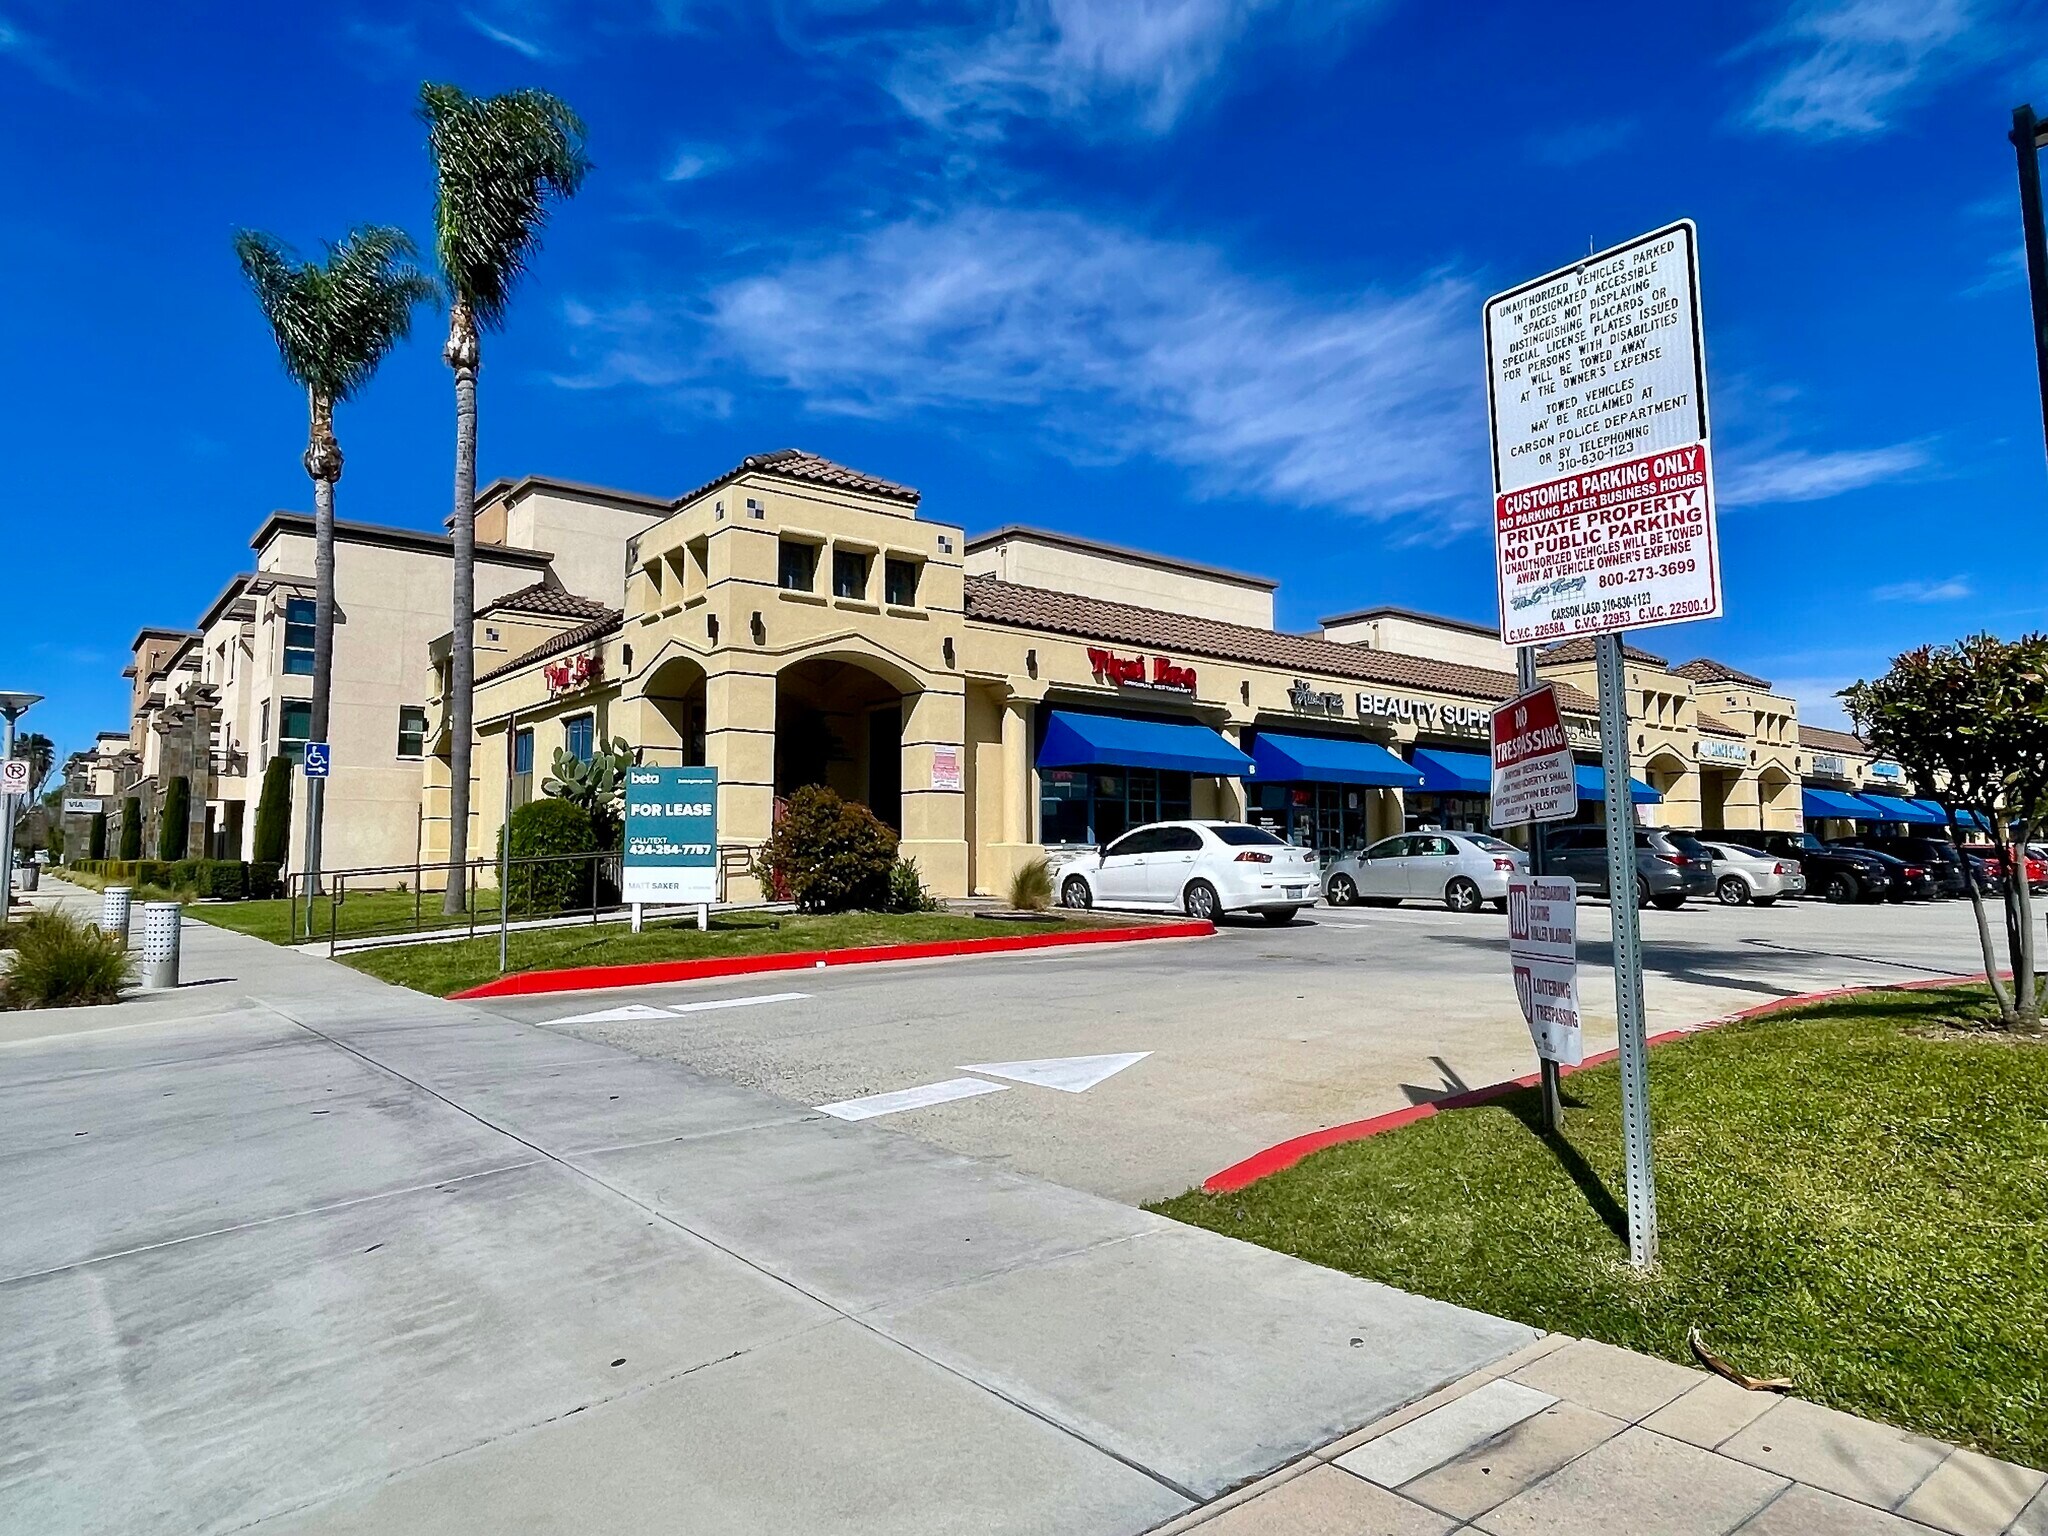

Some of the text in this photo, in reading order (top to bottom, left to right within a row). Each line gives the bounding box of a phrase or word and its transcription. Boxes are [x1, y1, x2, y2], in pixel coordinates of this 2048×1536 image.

[1500, 241, 1674, 317] UNAUTHORIZED VEHICLES PARKED
[1514, 262, 1658, 325] IN DESIGNATED ACCESSIBLE
[1510, 288, 1666, 353] DISTINGUISHING PLACARDS OR
[1523, 279, 1649, 335] SPACES NOT DISPLAYING
[1502, 298, 1678, 368] SPECIAL LICENSE PLATES ISSUED
[1504, 312, 1678, 381] FOR PERSONS WITH DISABILITIES
[1520, 347, 1662, 403] AT THE OWNER'S EXPENSE
[1531, 337, 1647, 386] WILL BE TOWED AWAY
[1531, 386, 1653, 433] MAY BE RECLAIMED AT
[1546, 378, 1634, 415] TOWED VEHICLES
[1510, 394, 1688, 457] CARSON POLICE DEPARTMENT
[1539, 425, 1649, 465] OR BY TELEPHONING
[1558, 442, 1634, 470] 310-830-1123
[1500, 472, 1703, 530] NO PARKING AFTER BUSINESS HOURS
[1505, 450, 1697, 516] CUSTOMER PARKING ONLY
[1504, 507, 1701, 562] NO PUBLIC PARKING
[1506, 490, 1696, 546] PRIVATE PROPERTY
[1505, 524, 1703, 575] UNAUTHORIZED VEHICLES WILL BE TOWED
[1516, 540, 1691, 585] AWAY AT VEHICLE OWNER'S EXPENSE
[1599, 559, 1696, 588] 800-273-3699
[1510, 598, 1708, 640] C.V.C. 22658A C.V.C. 22953 C.V.C. 22500.1
[1552, 592, 1650, 620] CARSON LASD 310-830-1123
[1360, 693, 1437, 720] BEAUTY
[1444, 705, 1490, 727] SUPP
[1514, 706, 1528, 729] NO
[1496, 724, 1562, 763] TRESPASSING
[631, 772, 659, 784] beta
[1540, 788, 1549, 797] BE
[1550, 784, 1572, 796] FOUND
[1549, 772, 1568, 782] SHALL
[631, 804, 712, 816] FOR LEASE
[1511, 890, 1526, 936] NO
[1516, 972, 1531, 1018] NO
[1533, 978, 1570, 999] LOITERING
[1536, 1004, 1578, 1028] TRESPASSING
